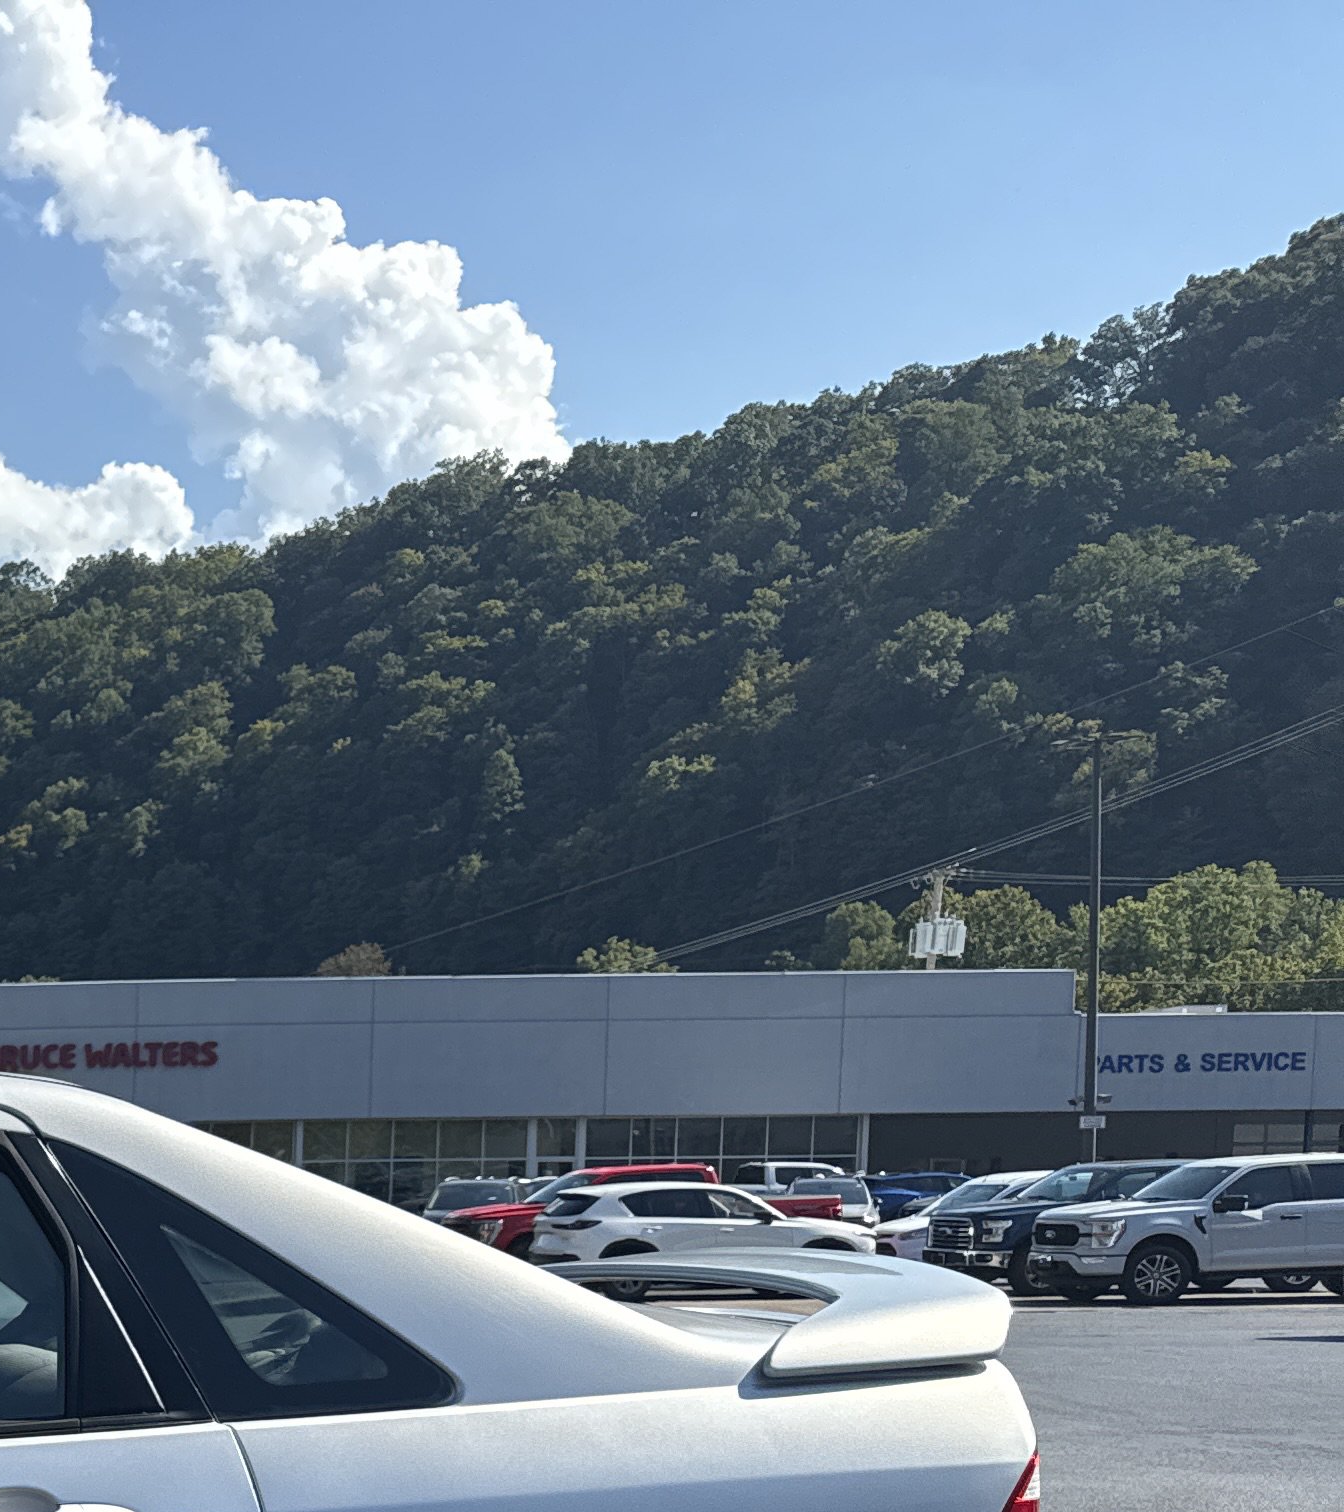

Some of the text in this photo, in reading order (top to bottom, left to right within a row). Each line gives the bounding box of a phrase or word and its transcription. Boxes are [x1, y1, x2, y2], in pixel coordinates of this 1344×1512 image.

[85, 1041, 218, 1069] WALTERS
[1096, 1051, 1308, 1073] ARTS & SERVICE
